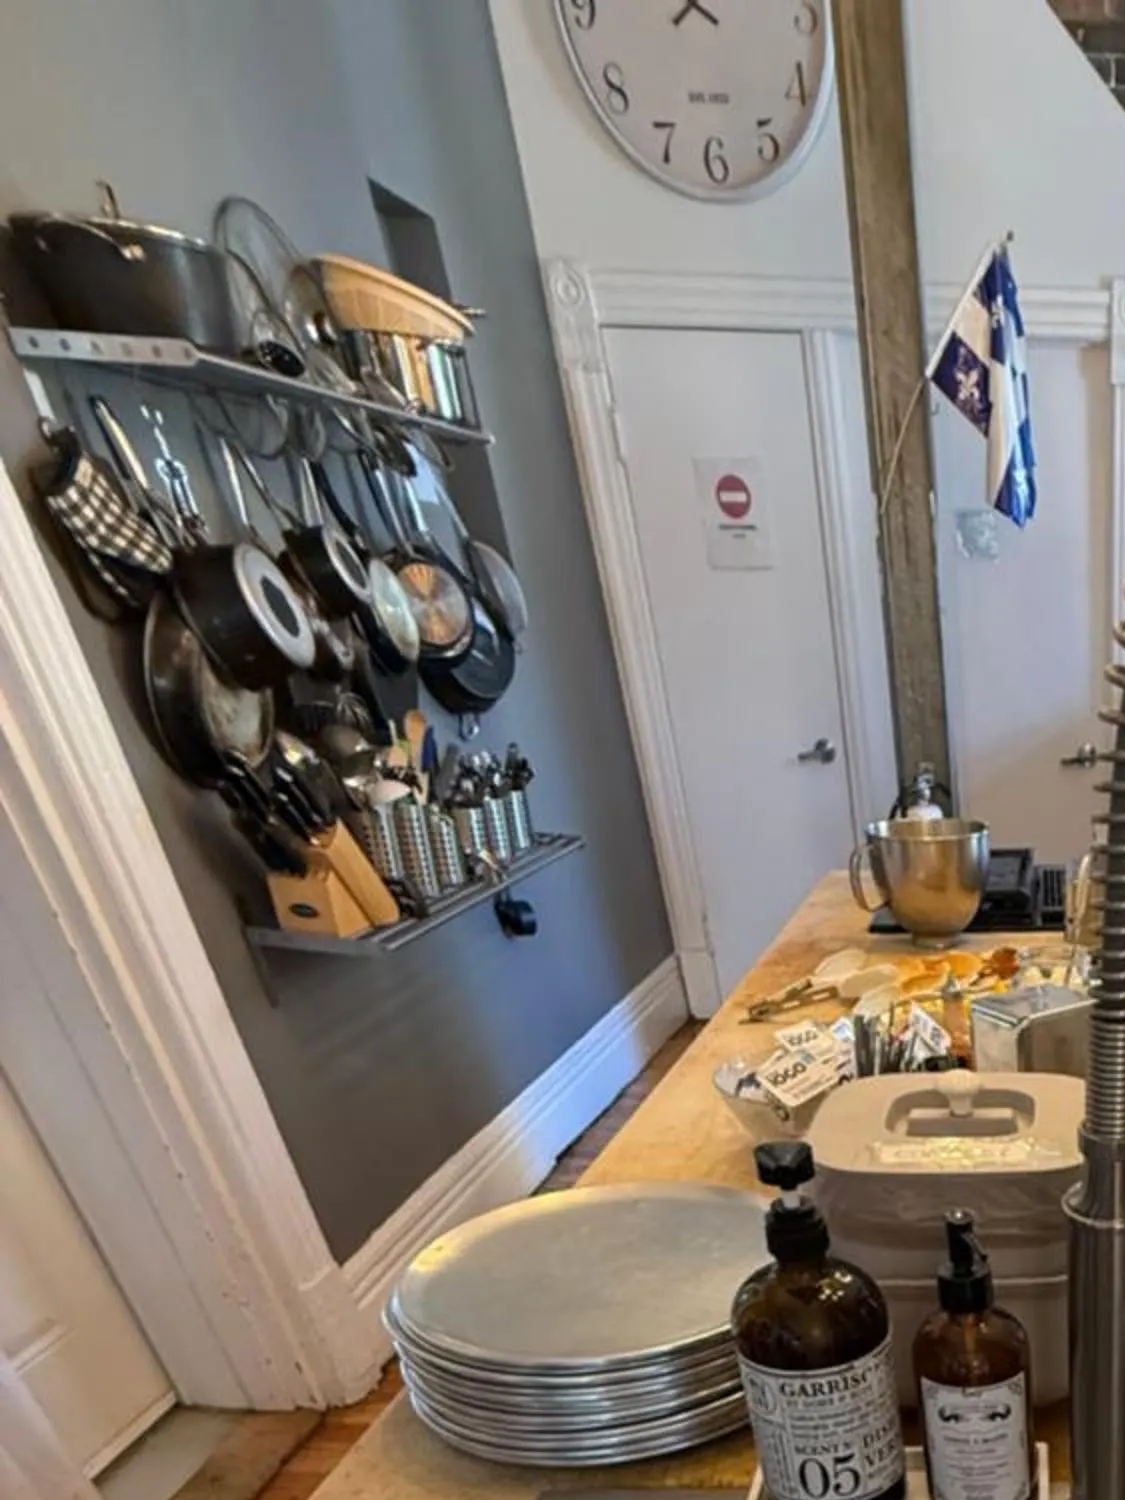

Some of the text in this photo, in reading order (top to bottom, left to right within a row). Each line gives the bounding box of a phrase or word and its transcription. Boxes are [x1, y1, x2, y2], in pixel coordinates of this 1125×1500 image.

[602, 62, 630, 115] 8
[784, 60, 808, 107] 4
[652, 120, 676, 165] 7
[703, 136, 730, 184] 6
[756, 117, 780, 163] 5
[798, 1453, 861, 1500] 05
